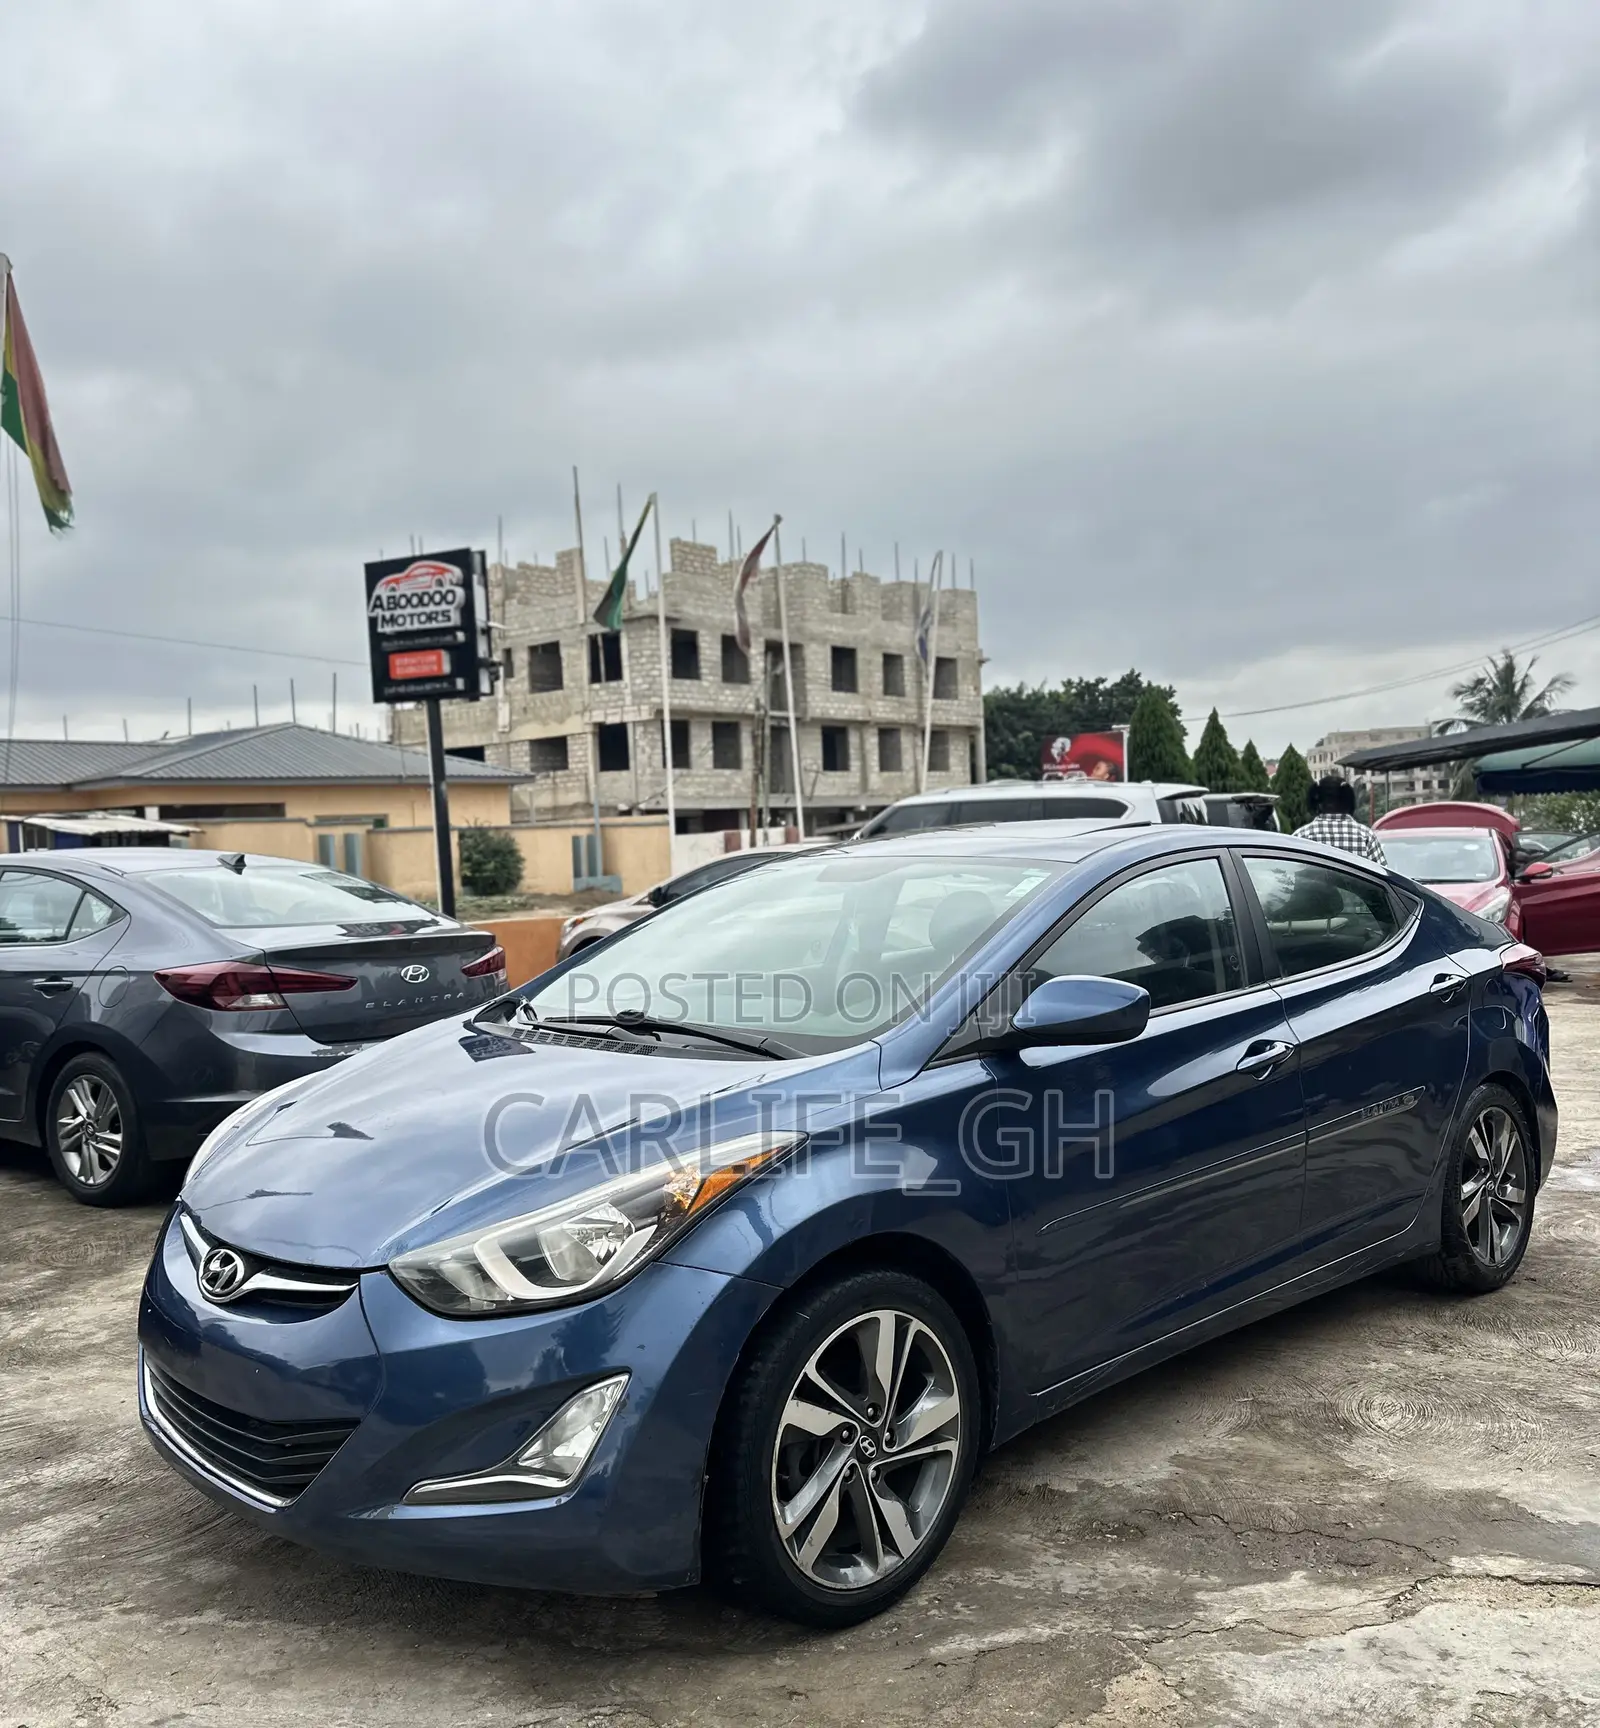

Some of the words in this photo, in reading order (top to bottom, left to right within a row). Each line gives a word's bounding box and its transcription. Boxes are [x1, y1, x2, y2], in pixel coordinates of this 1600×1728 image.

[371, 590, 456, 612] ABOODOO
[381, 610, 452, 628] MOTORS
[365, 992, 464, 1009] ELANTRA
